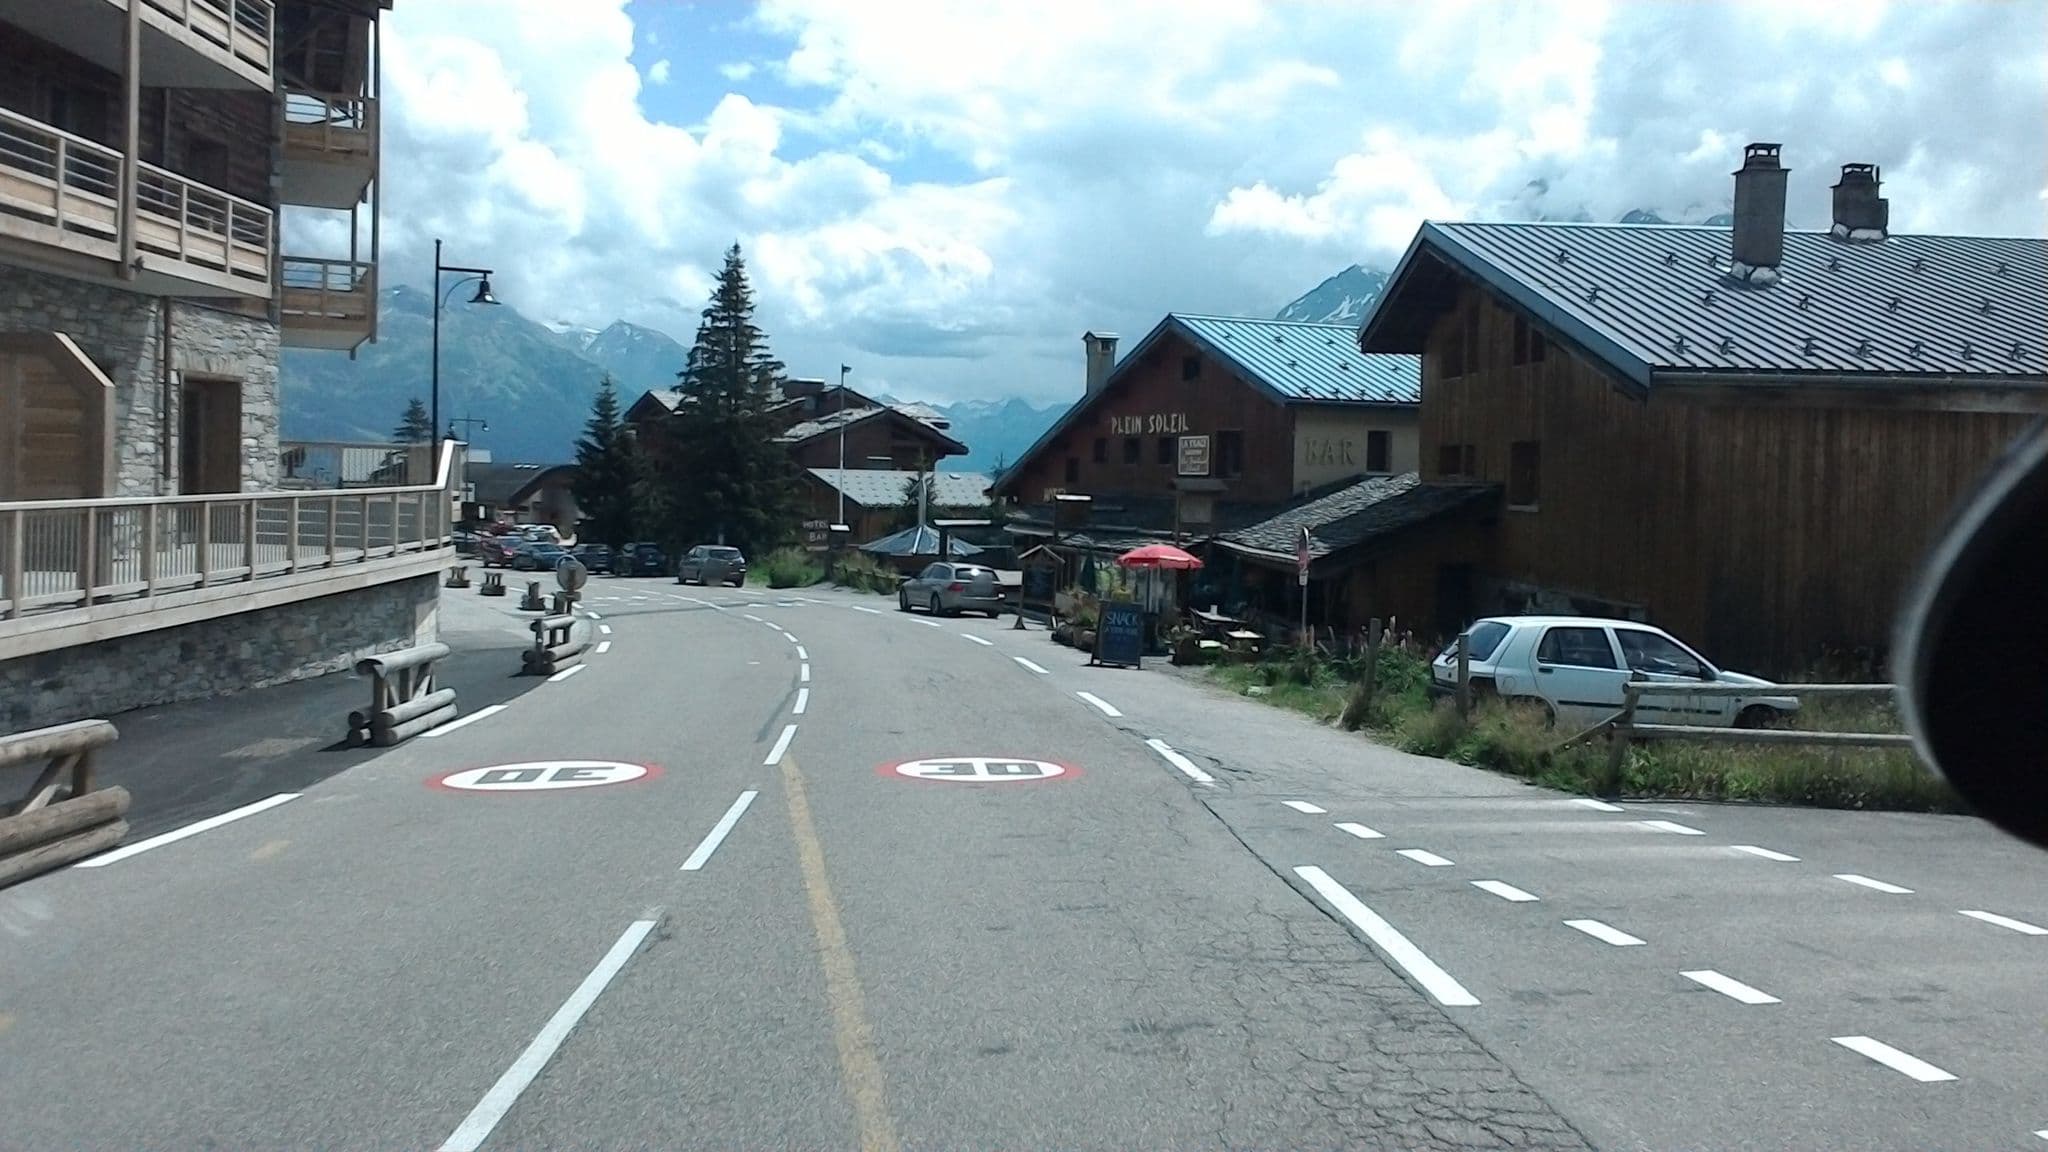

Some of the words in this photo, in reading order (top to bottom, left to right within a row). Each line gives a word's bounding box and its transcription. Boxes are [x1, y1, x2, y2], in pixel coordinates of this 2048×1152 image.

[1111, 416, 1142, 435] PLEIN
[1148, 414, 1189, 434] SOLEIL
[1304, 440, 1354, 466] BAR
[1105, 611, 1138, 626] SNACK
[920, 763, 1044, 776] 30
